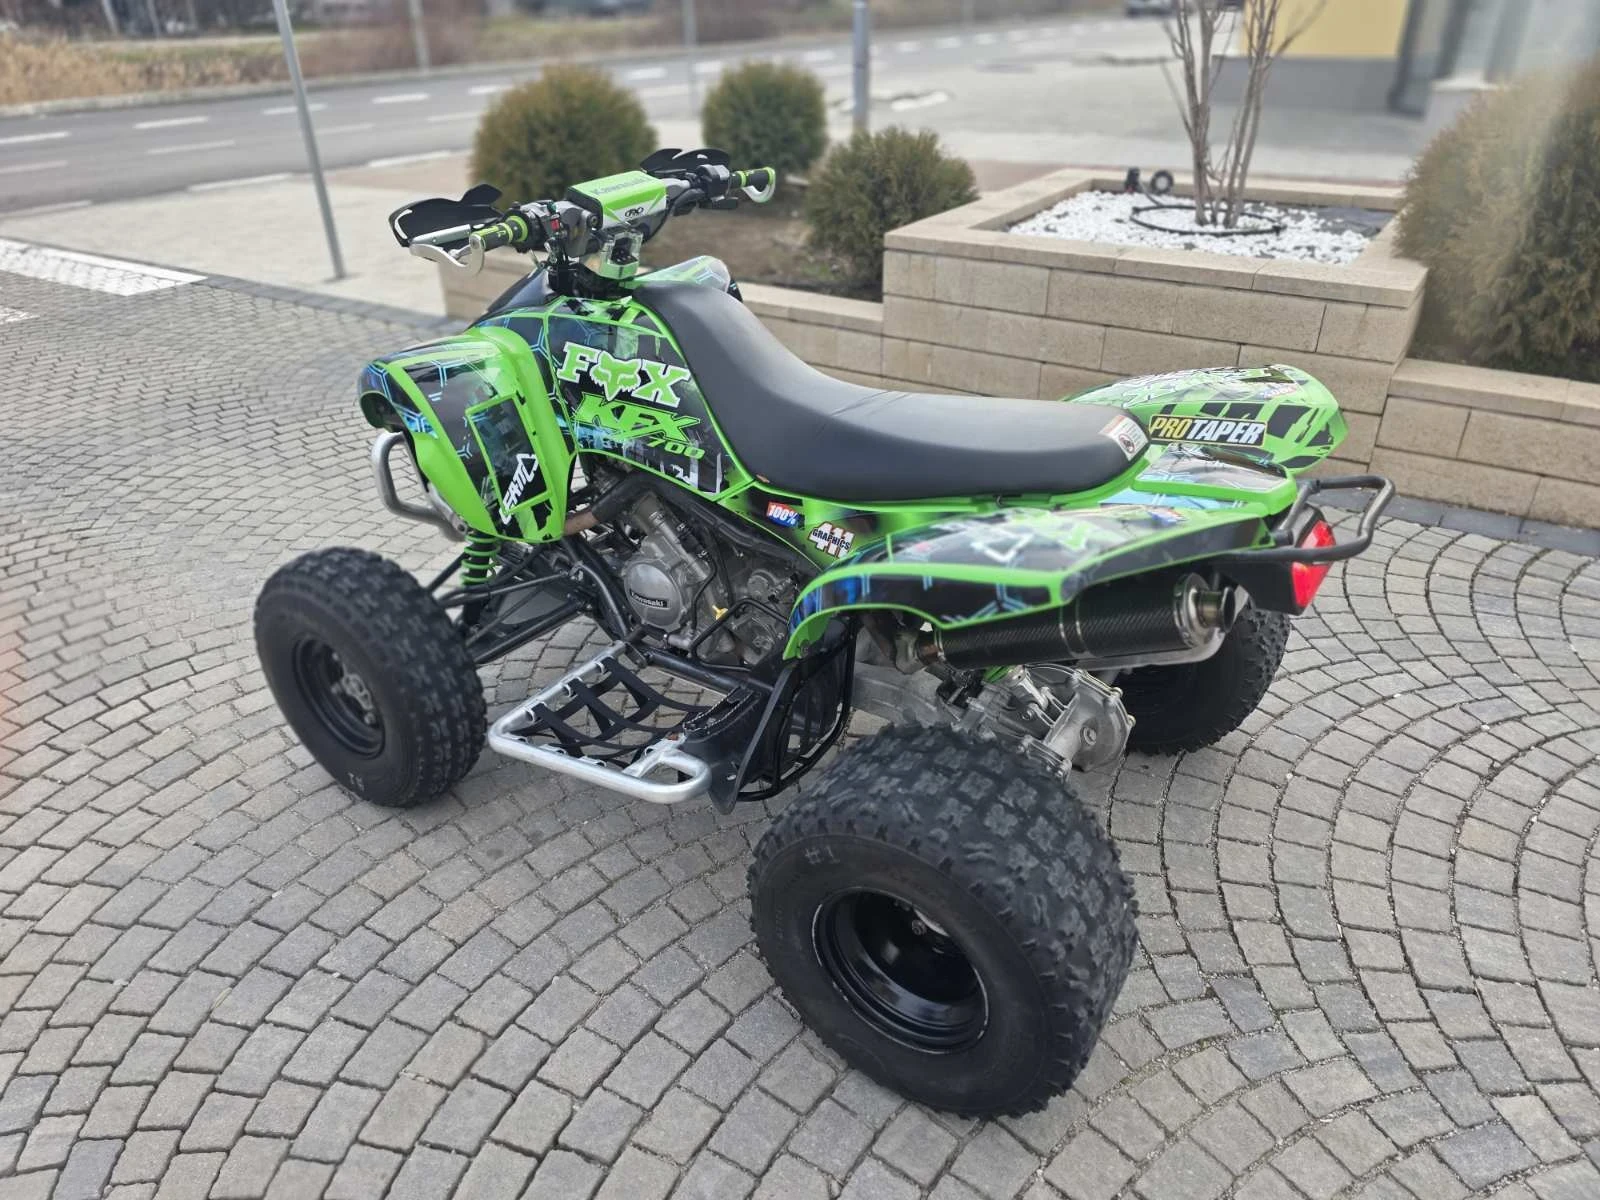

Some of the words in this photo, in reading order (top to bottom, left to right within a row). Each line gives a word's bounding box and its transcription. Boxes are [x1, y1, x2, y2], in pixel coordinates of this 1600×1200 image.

[648, 434, 705, 459] 700
[768, 504, 798, 525] 100%
[812, 528, 851, 550] GRAPHICS
